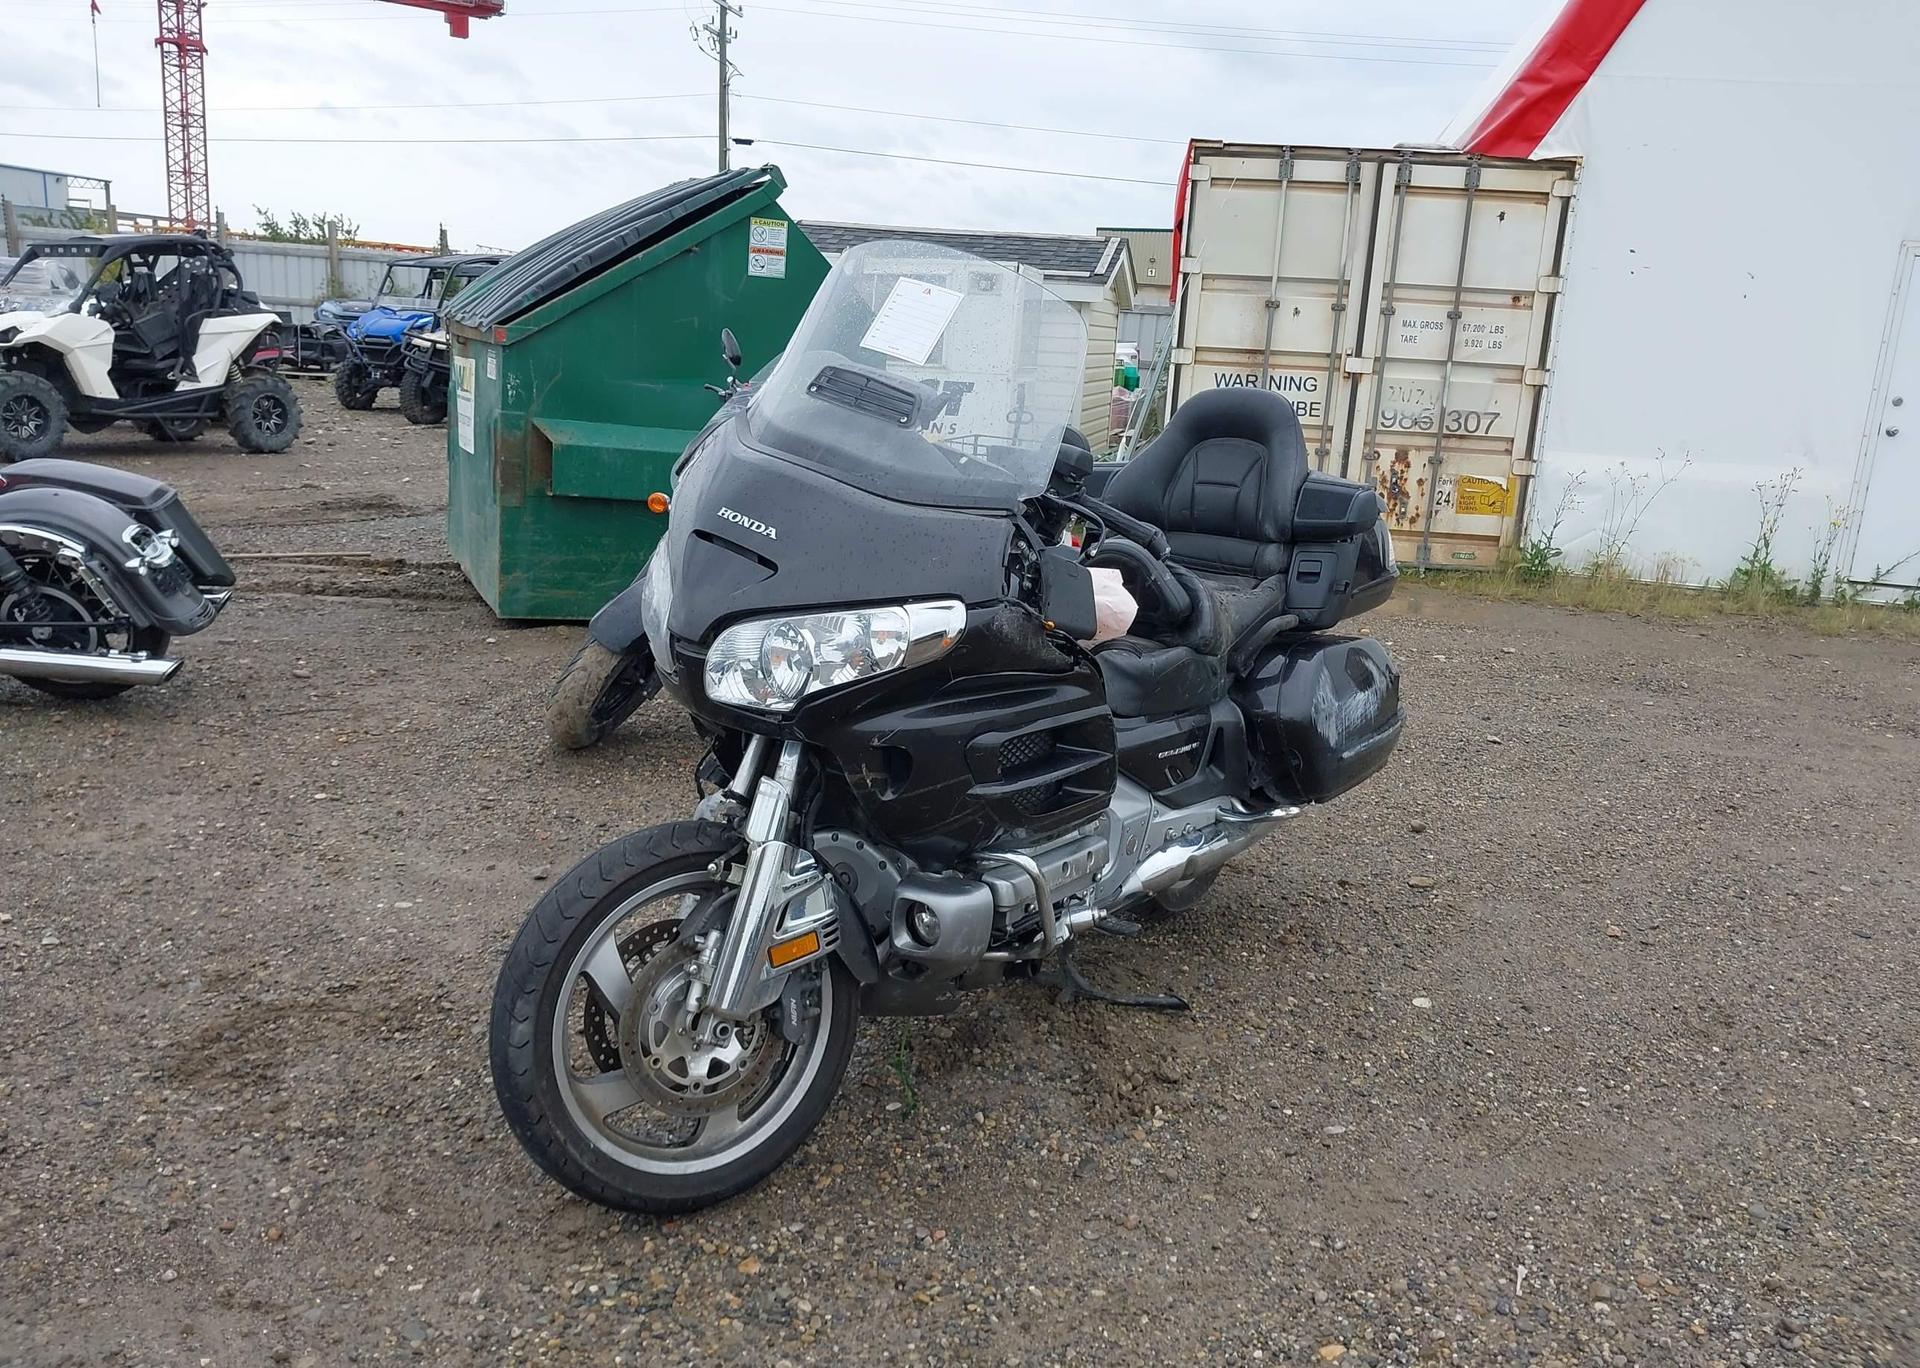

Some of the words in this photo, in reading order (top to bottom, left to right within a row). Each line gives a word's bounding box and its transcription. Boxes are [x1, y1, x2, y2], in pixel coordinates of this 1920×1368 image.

[756, 247, 784, 255] WARNING
[1420, 321, 1444, 331] GROSS
[1489, 325, 1505, 335] LBS
[1400, 334, 1418, 344] TARE
[1487, 340, 1503, 349] LBS
[1291, 401, 1322, 418] BE
[1445, 409, 1501, 434] 307
[717, 506, 777, 540] HONDA
